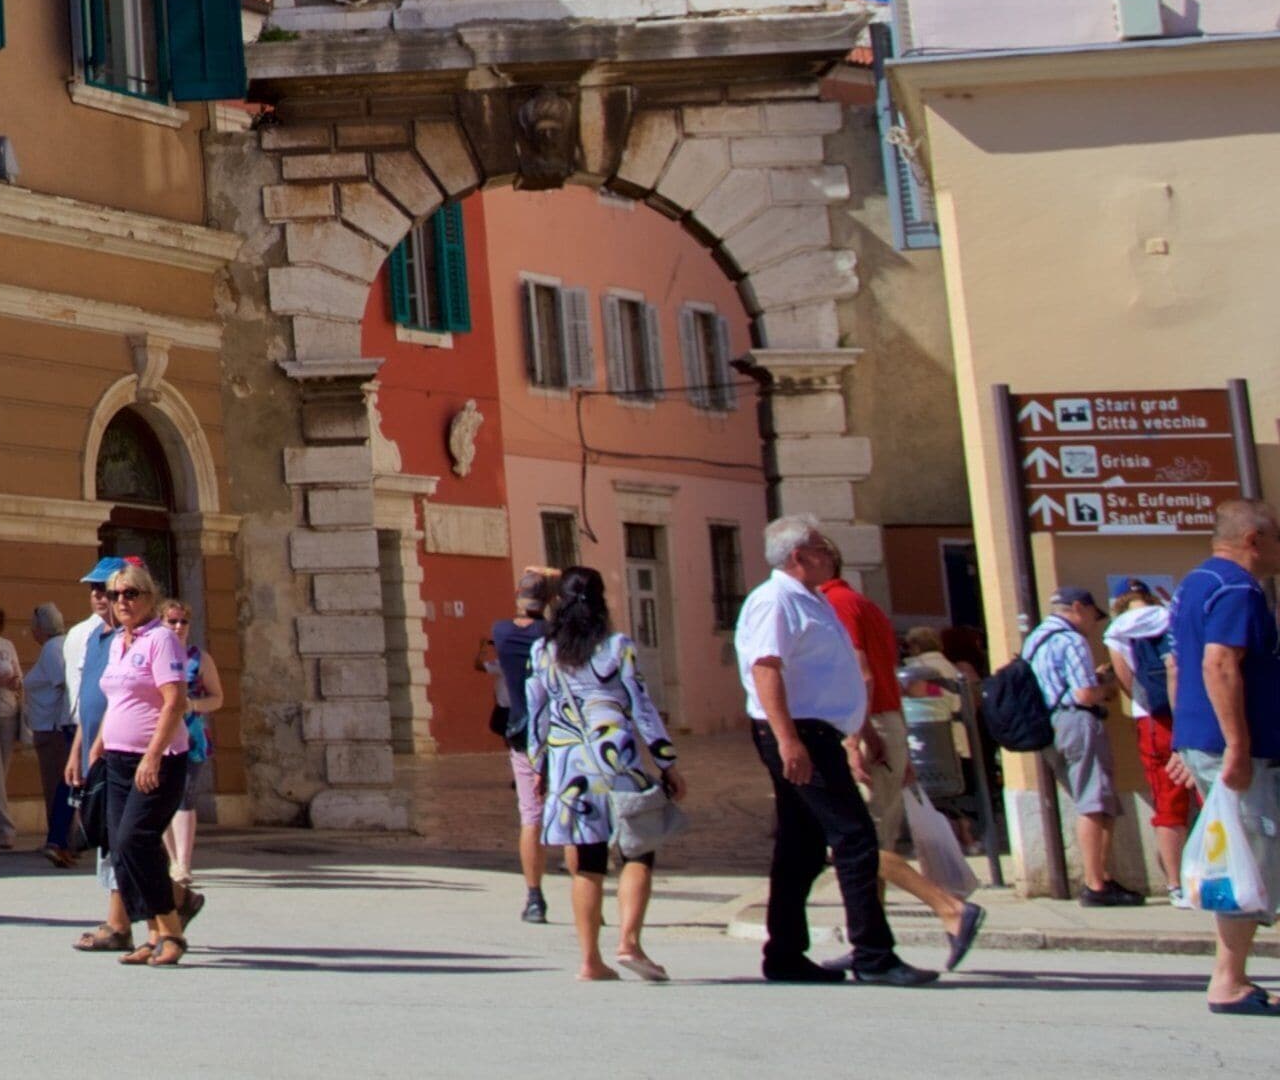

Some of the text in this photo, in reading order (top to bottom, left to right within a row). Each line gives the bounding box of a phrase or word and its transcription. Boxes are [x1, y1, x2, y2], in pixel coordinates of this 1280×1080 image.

[1095, 396, 1178, 414] Stari grad
[1143, 413, 1208, 429] vecchia
[1101, 453, 1151, 469] Grisia
[1106, 492, 1211, 510] Sv. Eufemija
[1156, 510, 1215, 525] Eufemi
